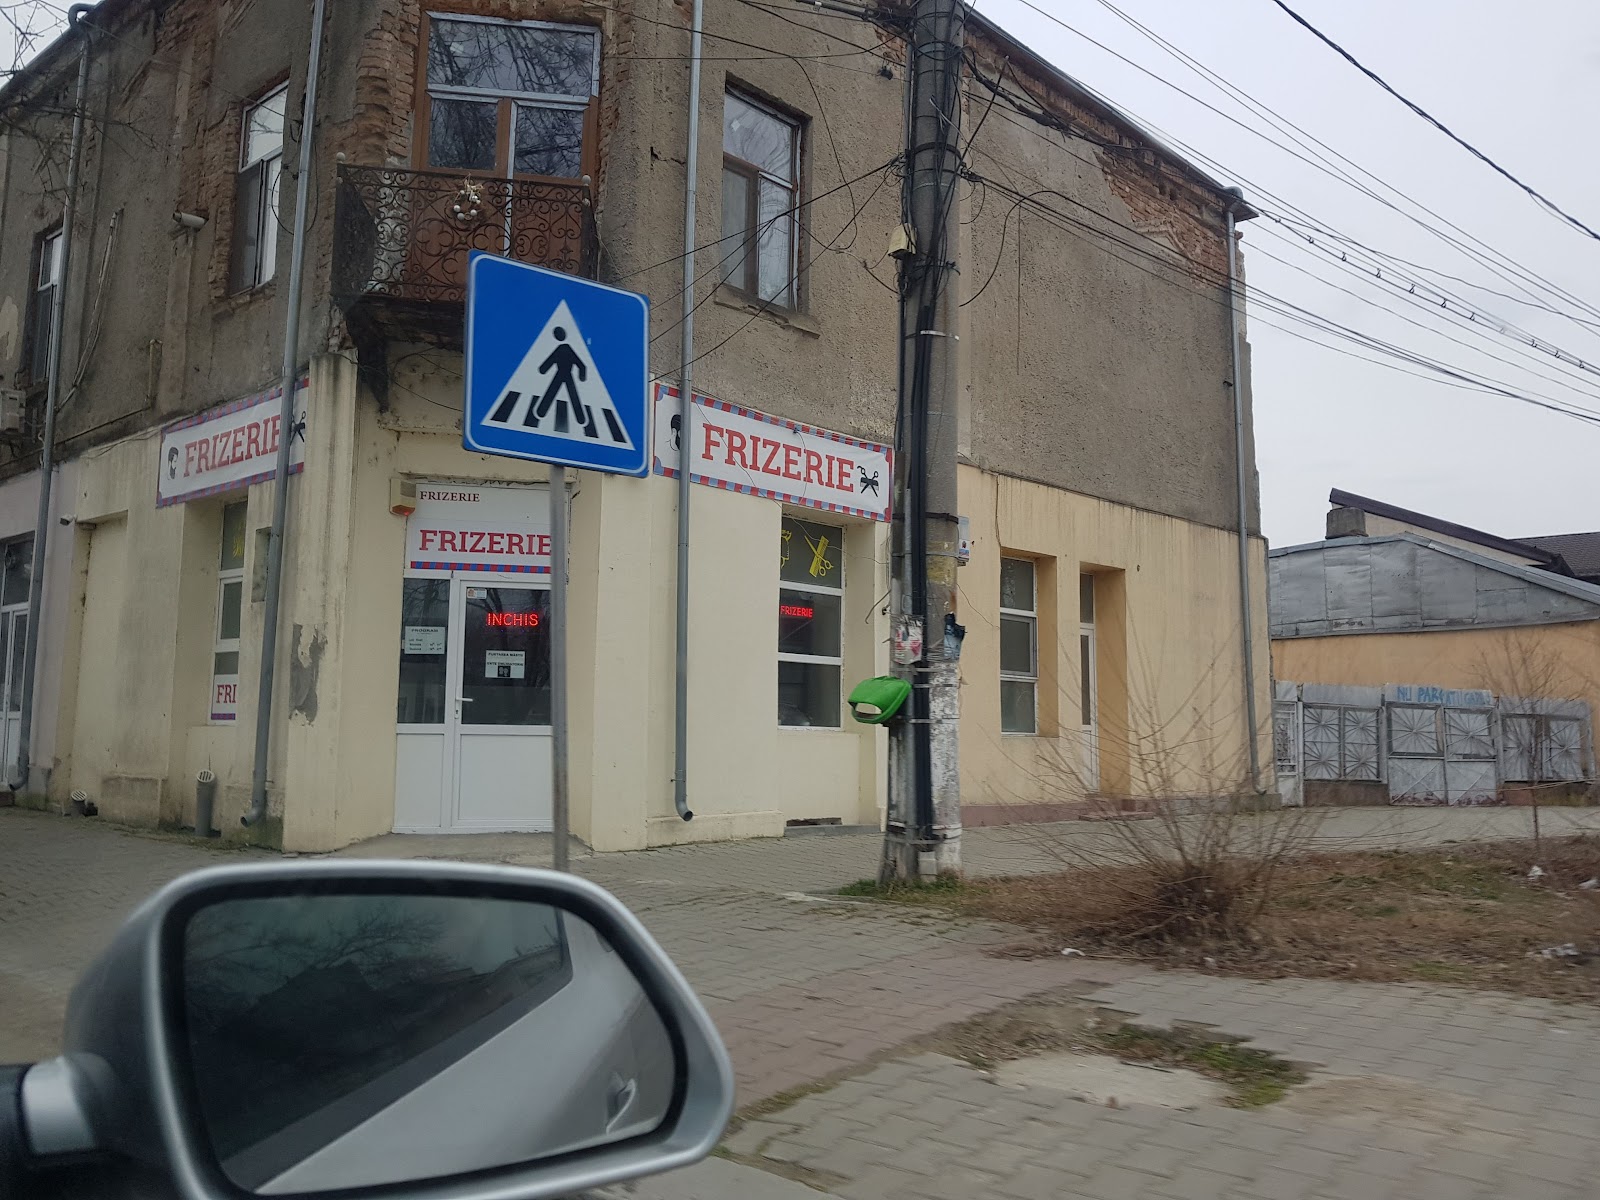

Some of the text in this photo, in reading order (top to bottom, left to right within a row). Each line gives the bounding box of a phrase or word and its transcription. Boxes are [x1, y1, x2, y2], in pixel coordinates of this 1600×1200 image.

[183, 414, 281, 477] FRIZERIE
[701, 423, 854, 493] FRIZERIE
[419, 490, 480, 502] FRIZERIE
[419, 529, 552, 556] FRIZERIE
[487, 612, 539, 626] INCHIS
[780, 605, 813, 618] FRIZERIE
[216, 684, 237, 704] FRI
